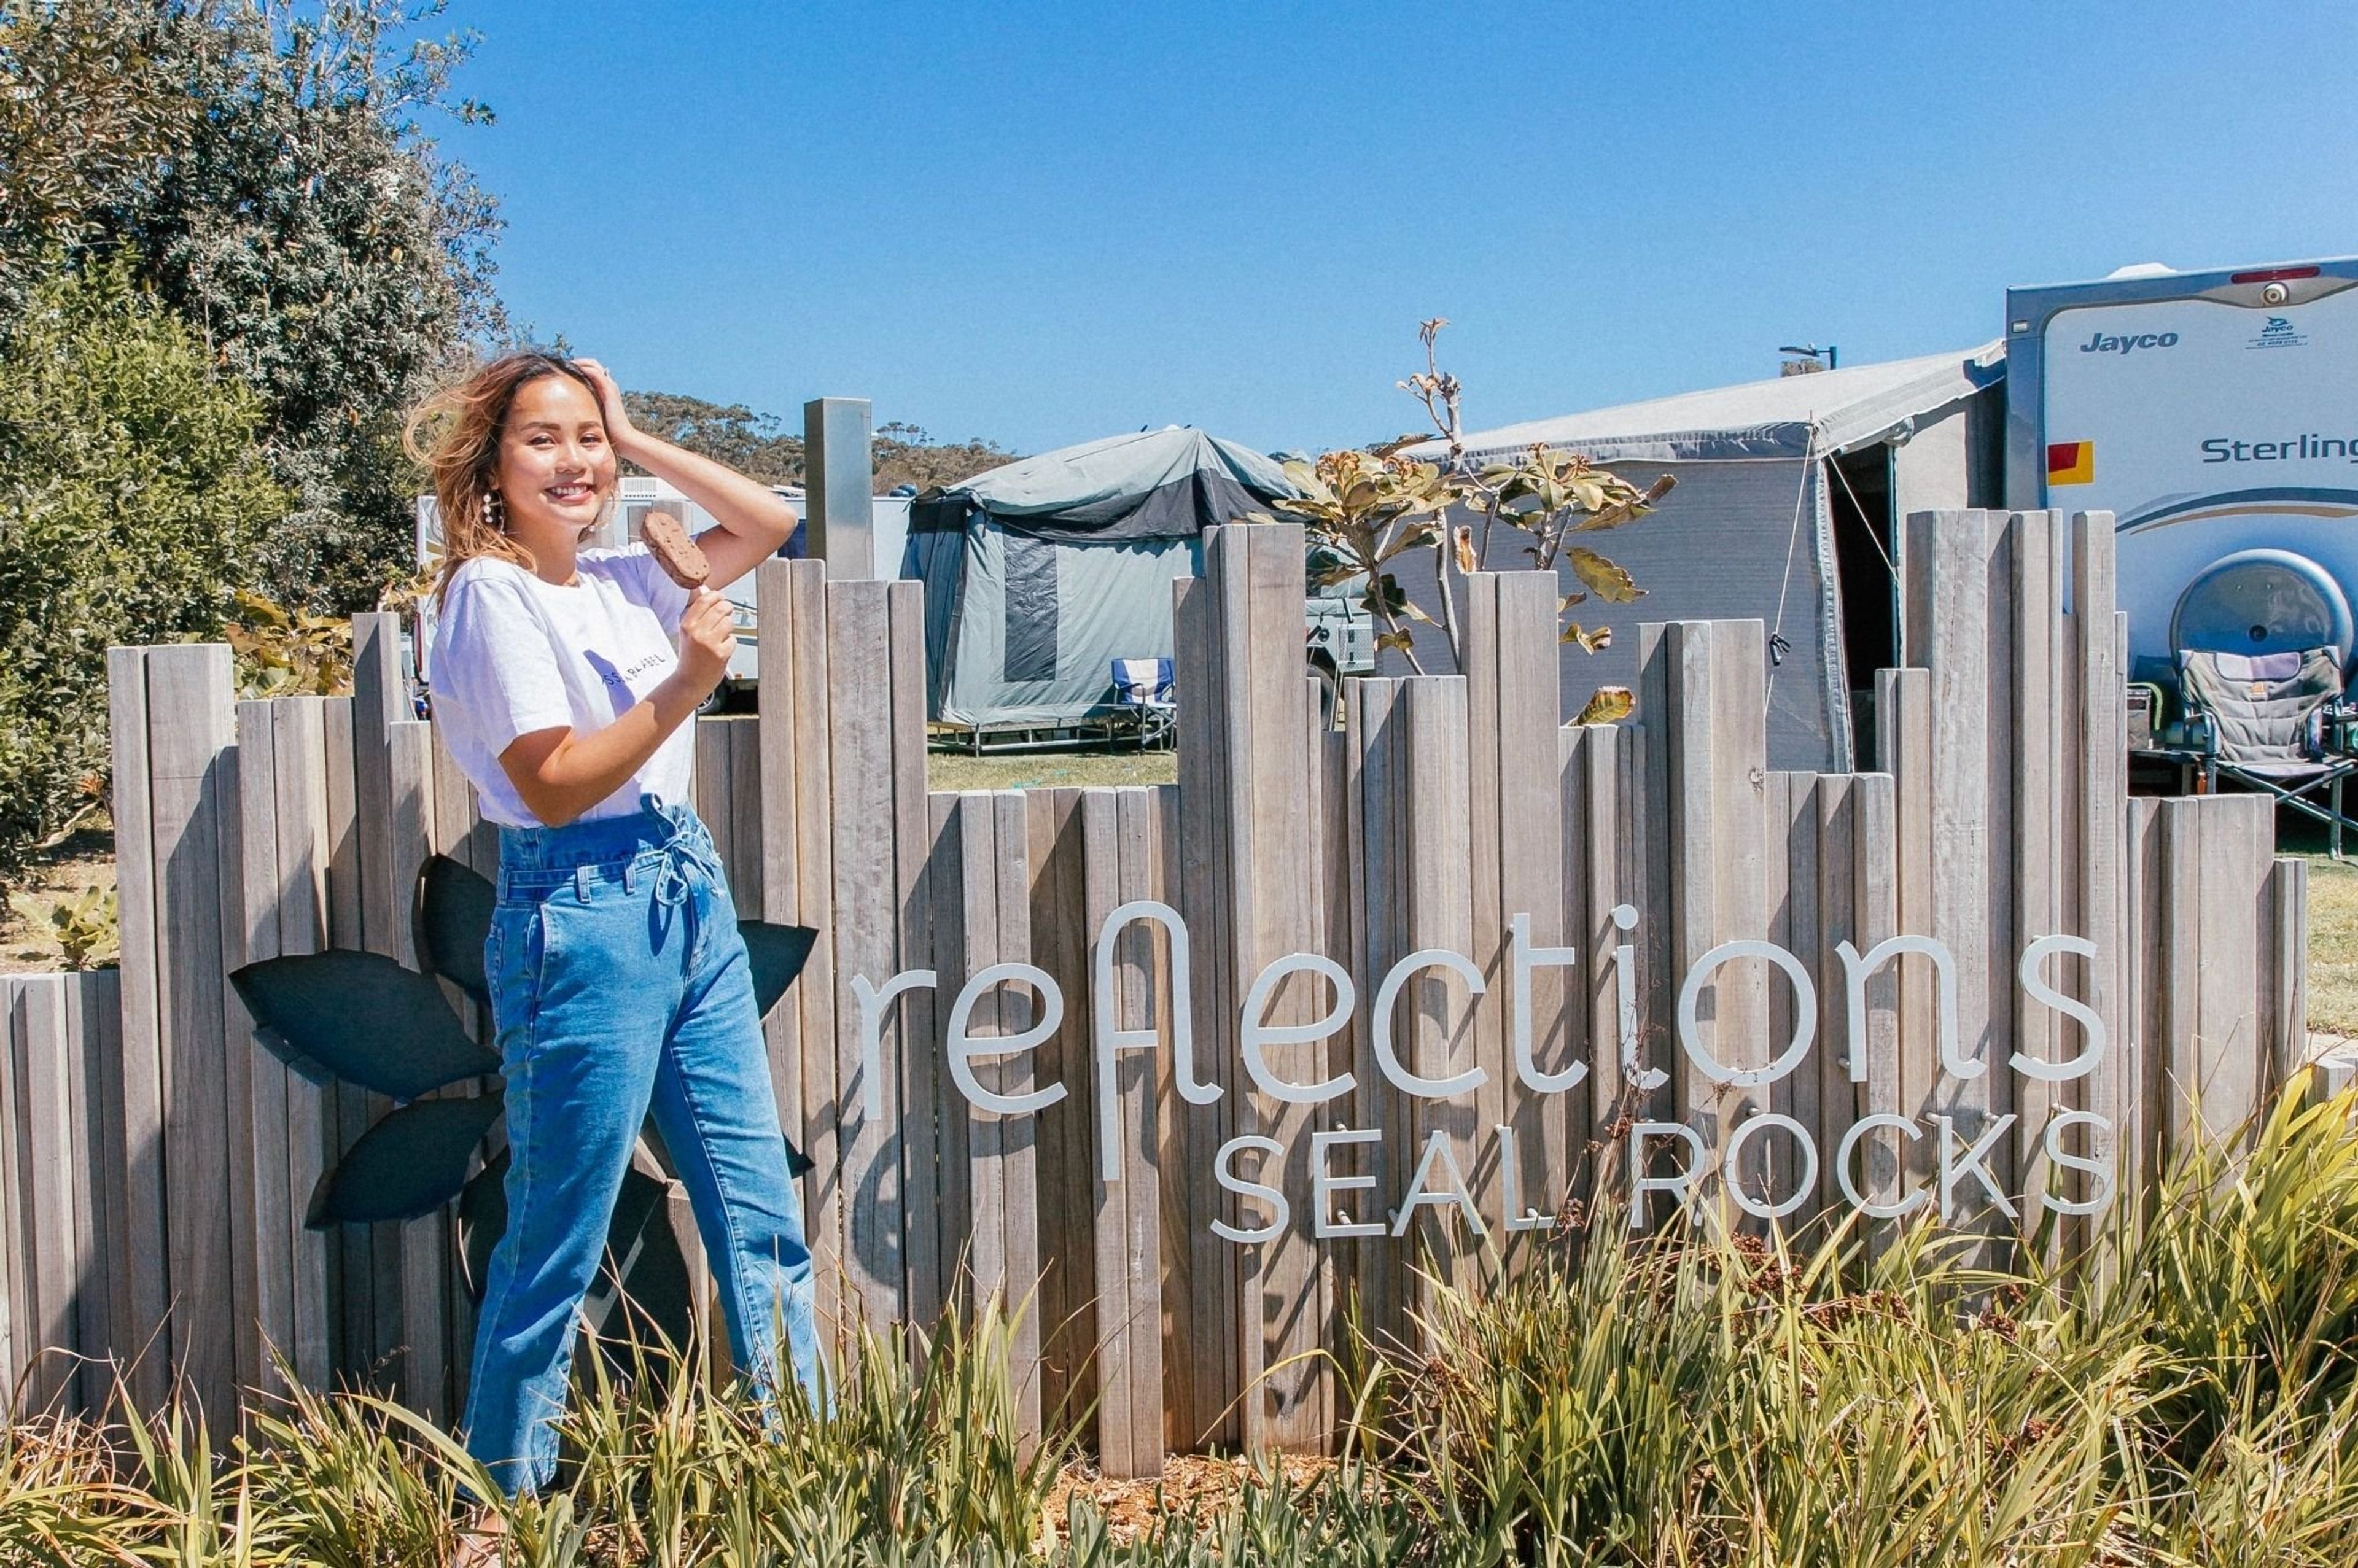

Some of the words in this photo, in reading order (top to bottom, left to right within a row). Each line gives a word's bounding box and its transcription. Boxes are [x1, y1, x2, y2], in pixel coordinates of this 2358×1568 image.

[2080, 332, 2179, 355] Jayco
[849, 899, 2106, 1181] reflections
[1210, 1125, 1560, 1243] SEAL
[1630, 1111, 2114, 1227] ROCKS
